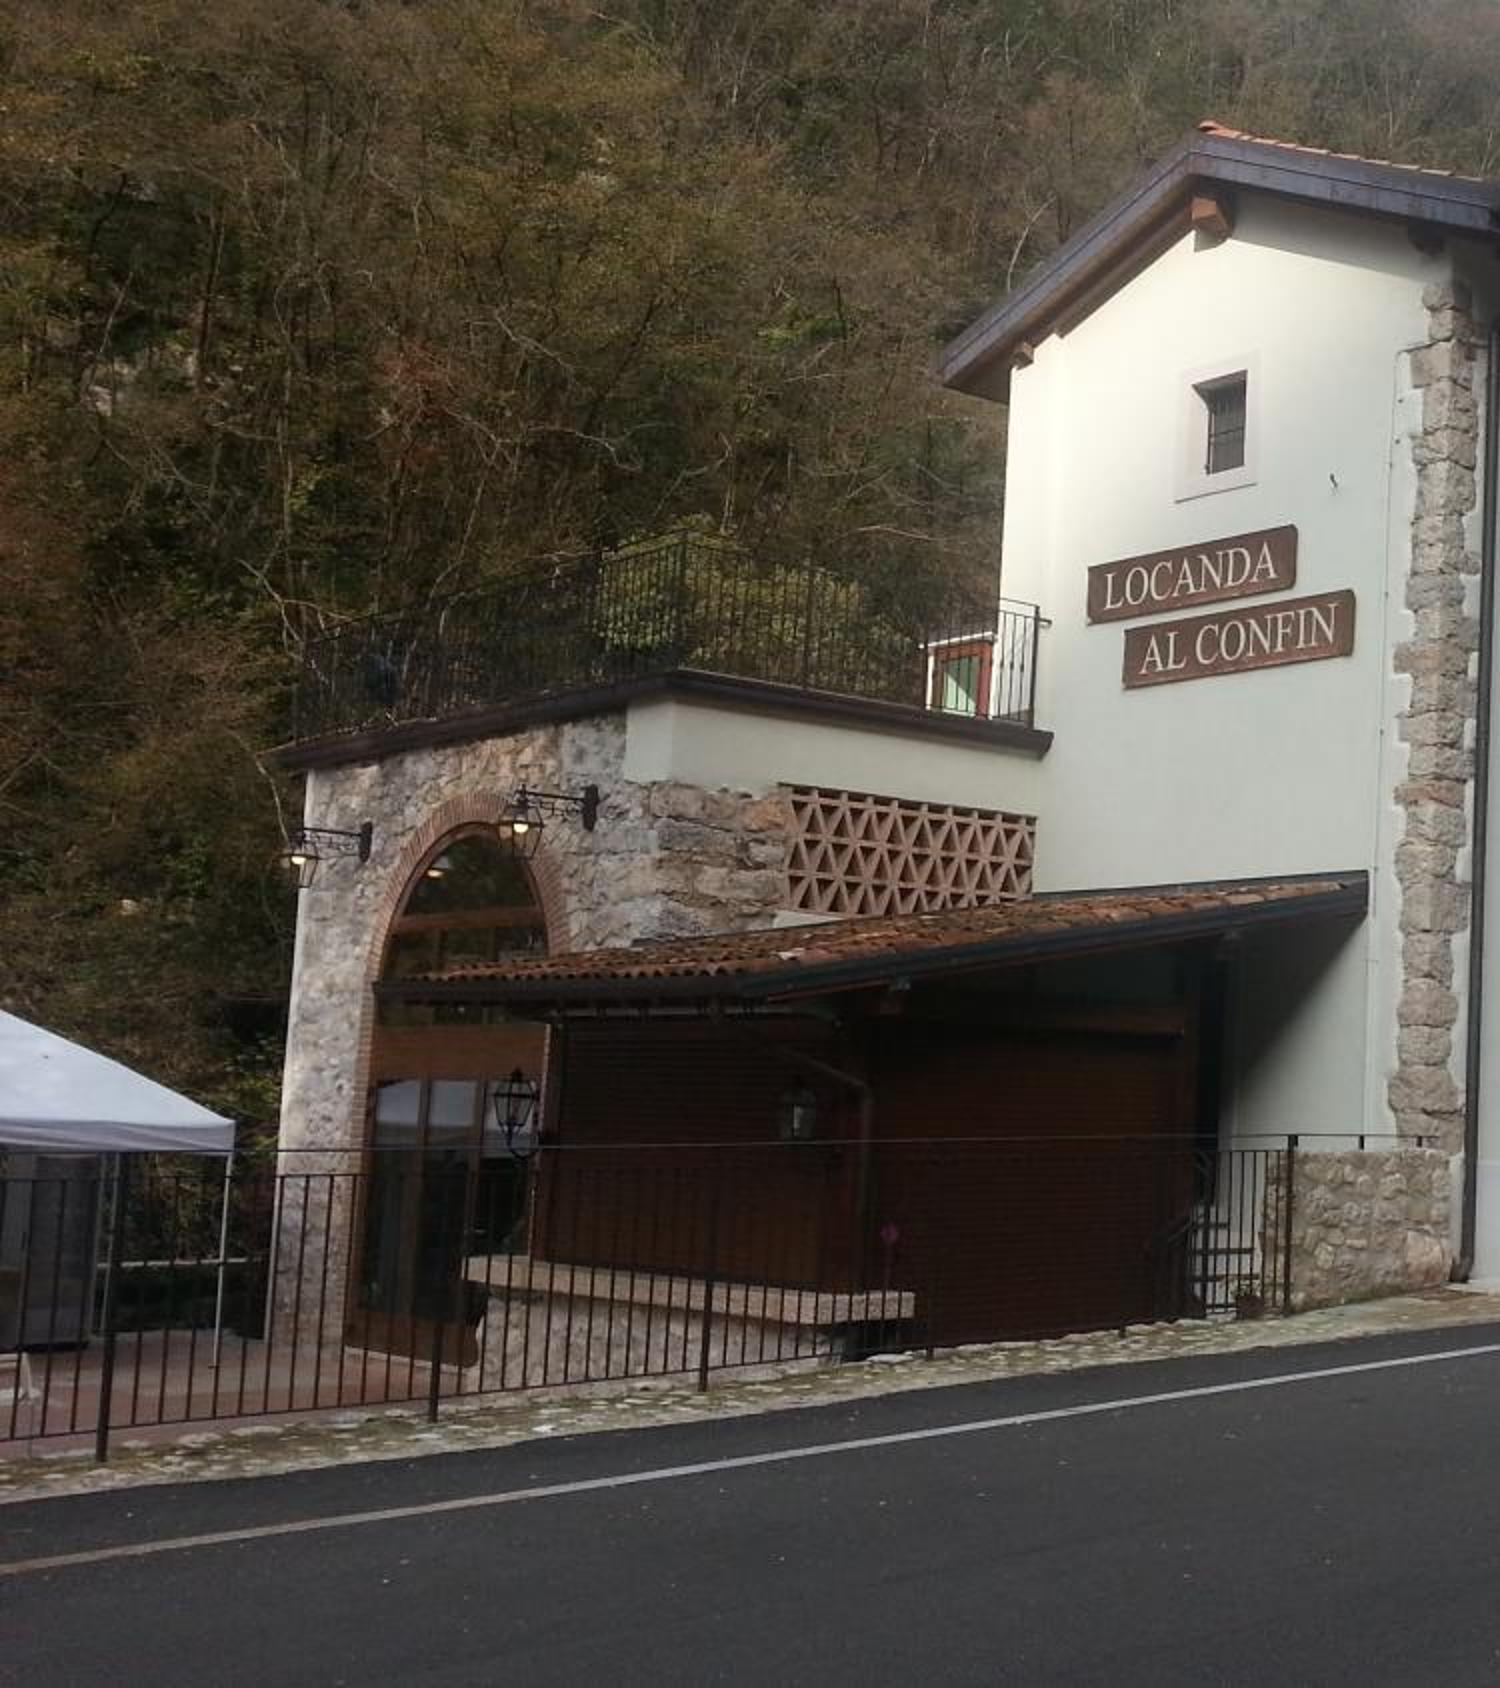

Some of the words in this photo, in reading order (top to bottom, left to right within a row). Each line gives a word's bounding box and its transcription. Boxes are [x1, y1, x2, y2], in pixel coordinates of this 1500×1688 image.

[1103, 541, 1279, 611] LOCANDA
[1138, 631, 1188, 676] AL
[1195, 603, 1340, 667] CONFIN
